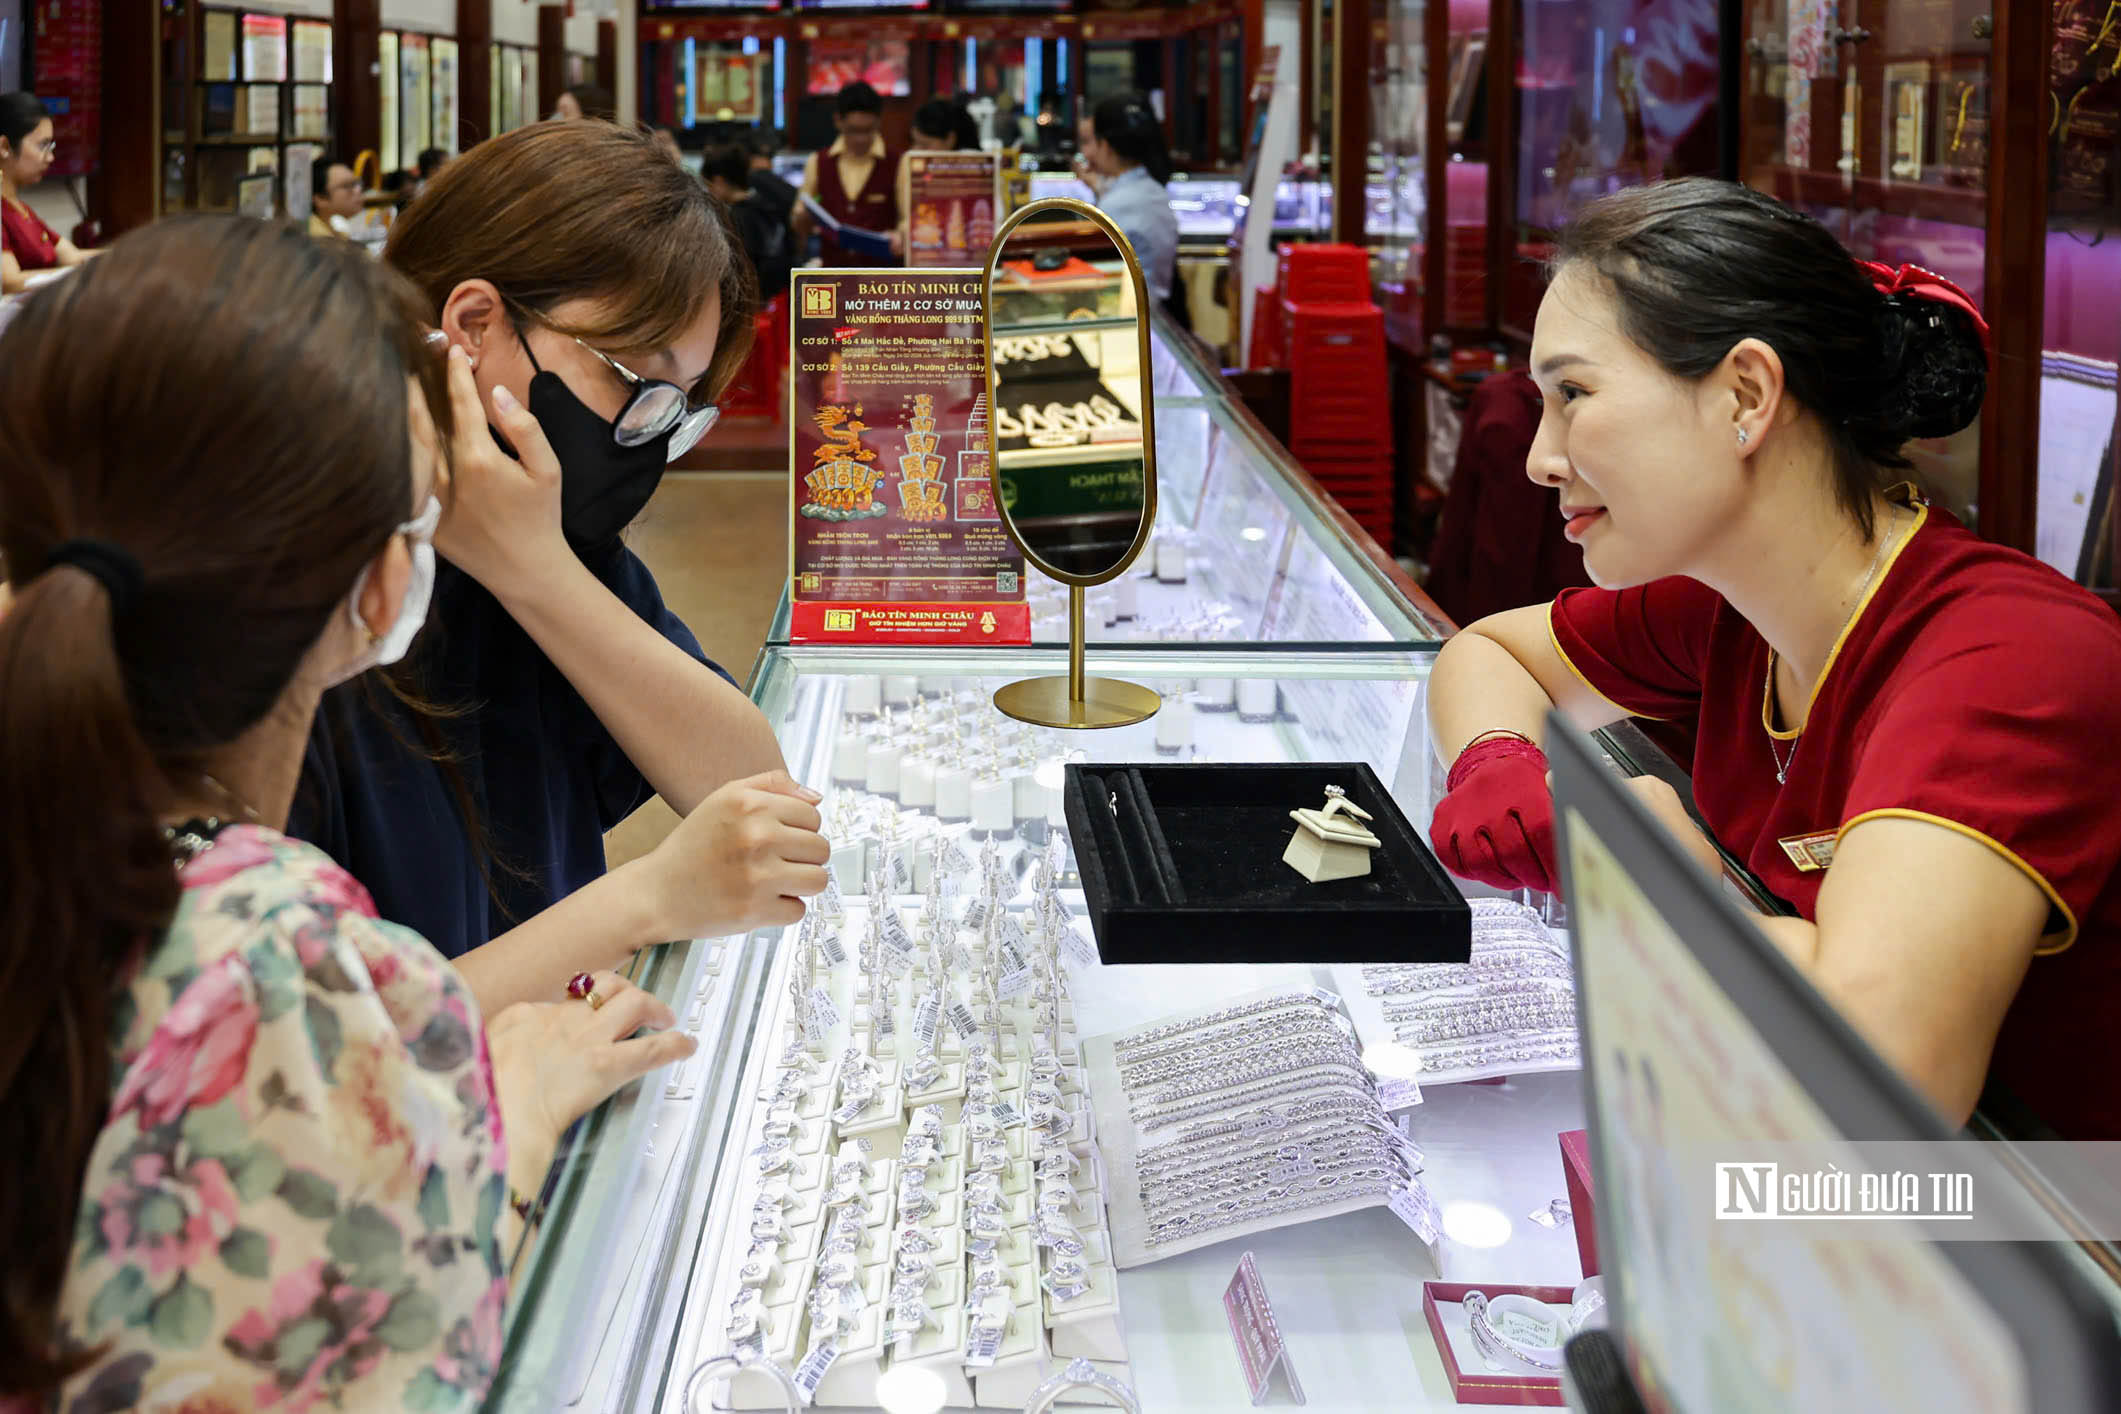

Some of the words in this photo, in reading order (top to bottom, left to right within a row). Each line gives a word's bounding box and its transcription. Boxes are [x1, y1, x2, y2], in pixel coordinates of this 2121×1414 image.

[858, 280, 889, 295] BẢO
[892, 280, 916, 295] TÍN
[921, 283, 959, 295] MINH
[845, 298, 866, 310] MỞ
[868, 298, 901, 310] THÊM
[903, 300, 911, 310] 2
[913, 300, 932, 310] CƠ
[935, 298, 953, 310] SỞ
[955, 300, 983, 310] MUA
[845, 313, 868, 324] VÀNG
[893, 314, 920, 324] THĂNG
[922, 315, 943, 324] LONG
[861, 337, 875, 345] Mai
[939, 337, 952, 345] Hai
[862, 611, 886, 619] BẢO
[888, 610, 908, 619] TÍN
[943, 611, 975, 619] CHÂU
